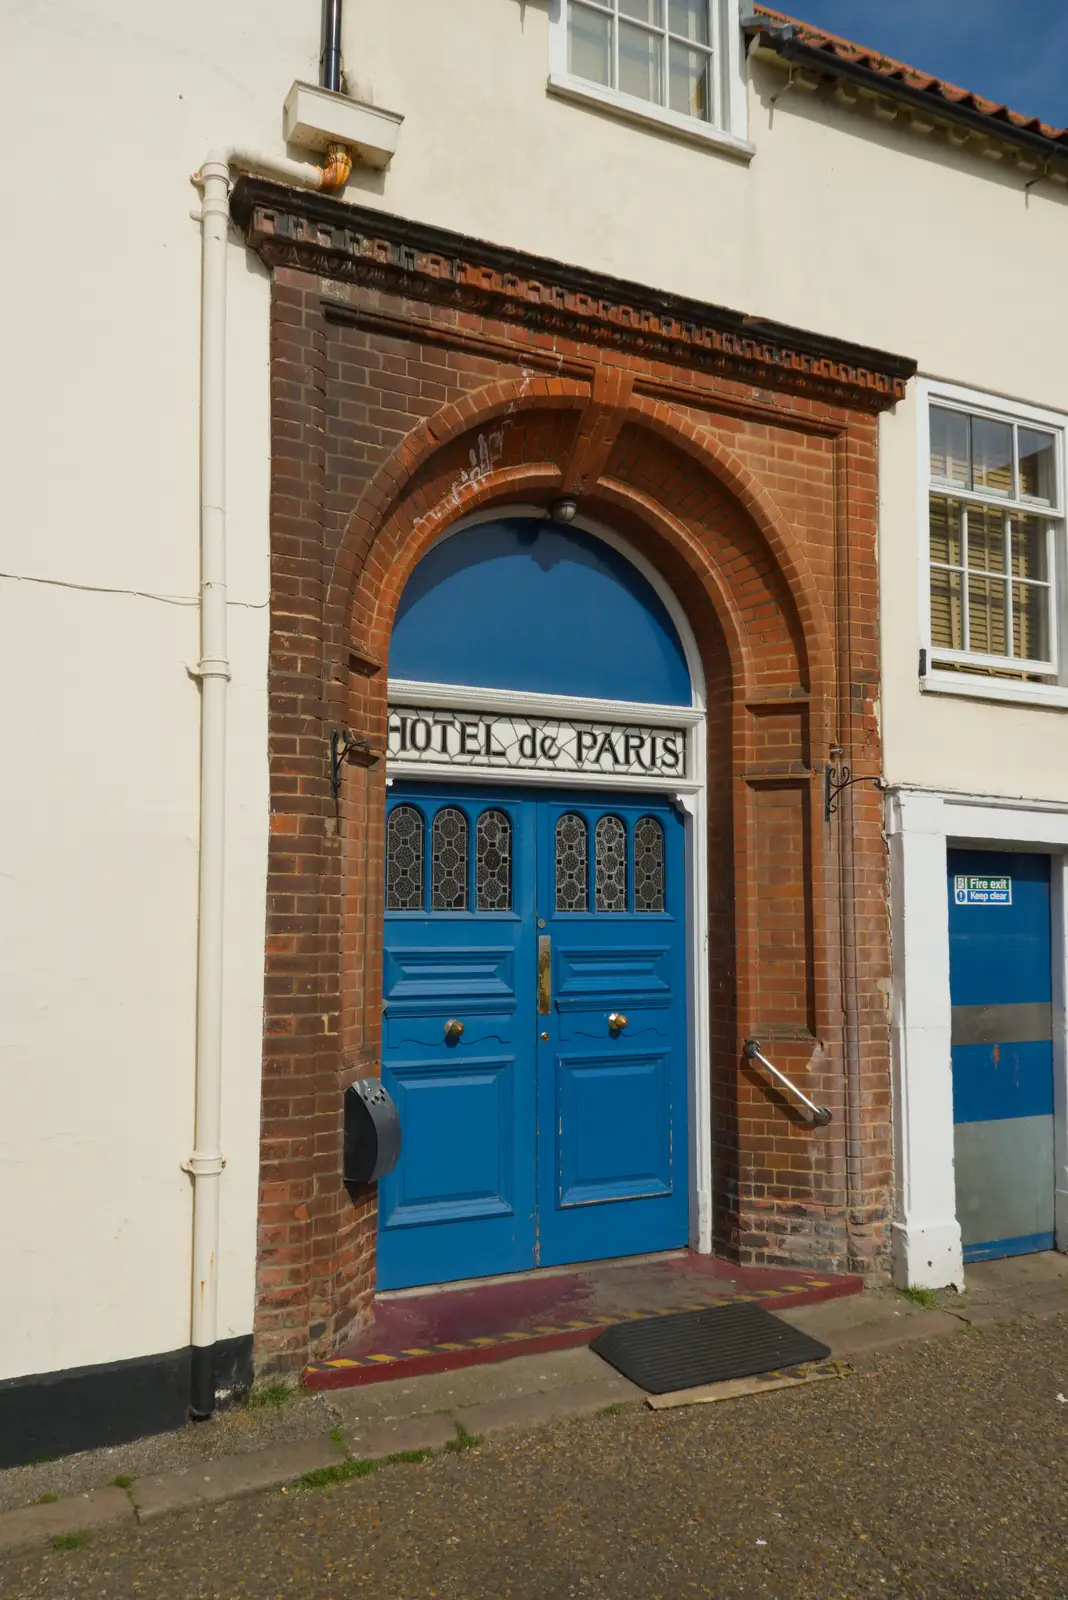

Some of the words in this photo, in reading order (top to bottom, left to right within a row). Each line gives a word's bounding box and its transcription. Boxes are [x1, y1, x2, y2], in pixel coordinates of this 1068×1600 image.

[387, 716, 507, 757] HOTEL
[518, 727, 562, 760] de
[575, 730, 681, 770] PARIS
[970, 878, 988, 889] Fire
[990, 879, 1007, 889] exit
[970, 891, 988, 902] Keep
[990, 892, 1007, 900] clear
